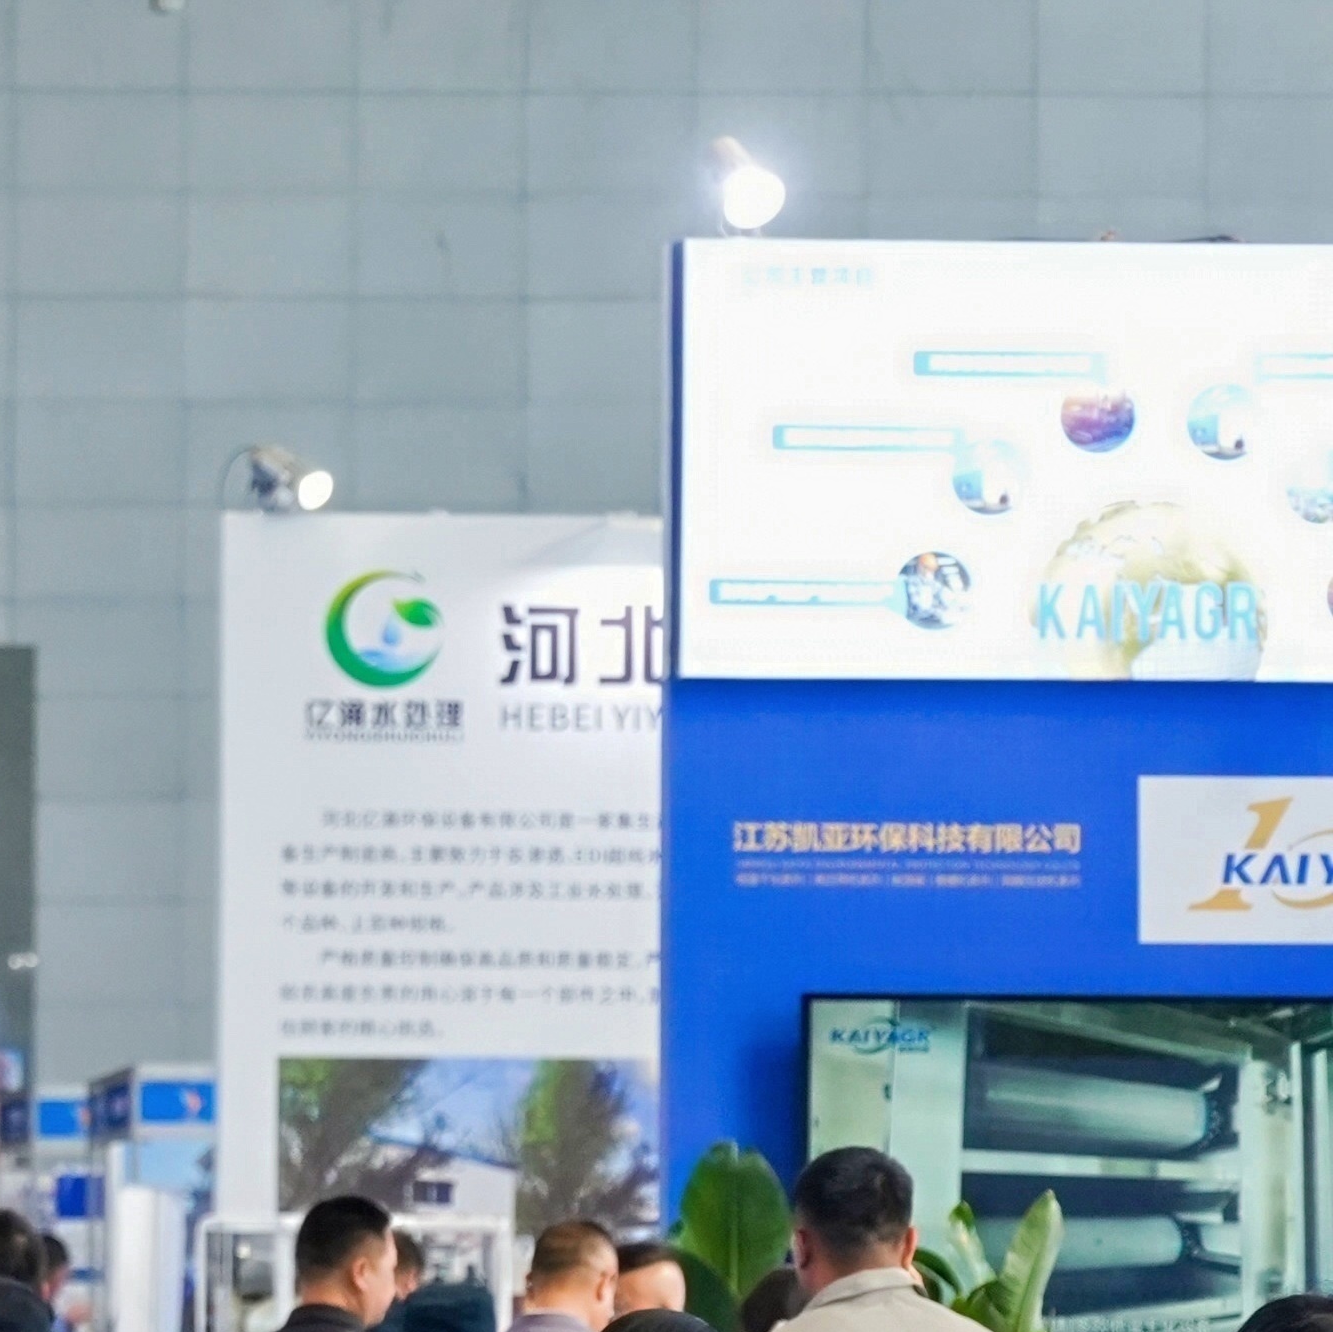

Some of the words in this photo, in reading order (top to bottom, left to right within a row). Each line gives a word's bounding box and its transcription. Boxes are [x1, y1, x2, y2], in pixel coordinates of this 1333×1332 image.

[1038, 582, 1258, 641] KAIYAGR
[500, 703, 604, 731] HEBEI
[734, 820, 1081, 854] 江苏凯亚环保科技有限公司
